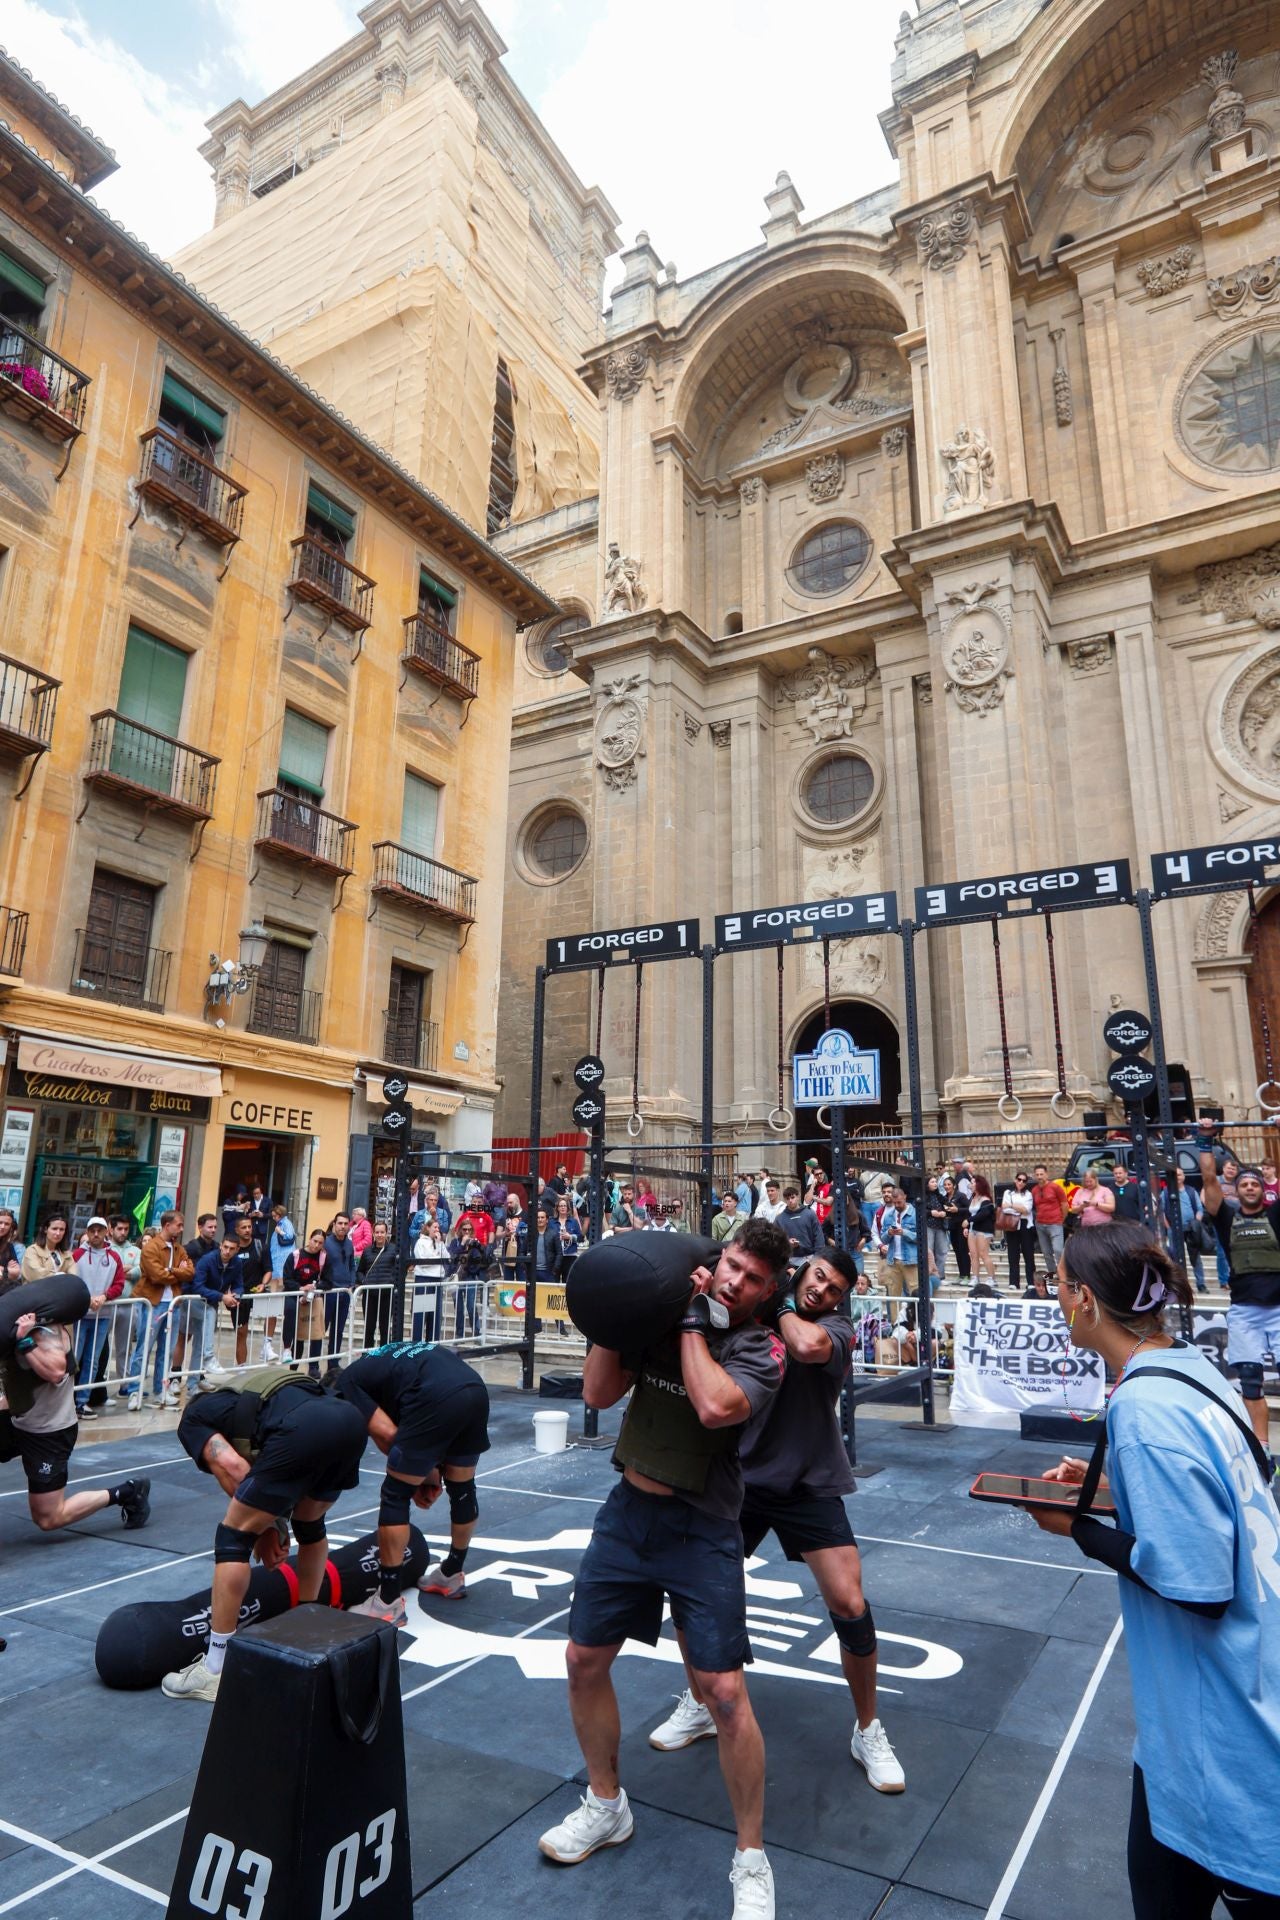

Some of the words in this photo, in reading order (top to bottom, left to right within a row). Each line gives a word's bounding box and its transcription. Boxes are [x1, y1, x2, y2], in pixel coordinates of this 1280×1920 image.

[1165, 855, 1191, 882] 4
[1205, 844, 1280, 868] FOR
[926, 889, 947, 915] 3
[959, 872, 1080, 902] FORGED
[1094, 866, 1118, 894] 3
[725, 917, 741, 941] 2
[753, 902, 854, 929] FORGED
[866, 898, 885, 923] 2
[557, 941, 566, 963] 1
[578, 928, 664, 952] FORGED
[678, 924, 686, 947] 1
[32, 1049, 110, 1078] Cuadros
[114, 1063, 164, 1086] Mora
[24, 1072, 112, 1105] Cuadros
[149, 1090, 192, 1112] Mora
[801, 1076, 835, 1097] THE
[841, 1074, 871, 1095] BOX
[230, 1101, 313, 1131] COFFEE
[645, 1204, 660, 1213] THE
[662, 1205, 677, 1214] BOX
[1029, 1305, 1065, 1321] BO
[963, 1346, 1021, 1375] THE
[1027, 1357, 1100, 1379] BOX
[659, 1379, 687, 1396] PICS
[189, 1832, 272, 1920] 03
[320, 1808, 396, 1920] 03
